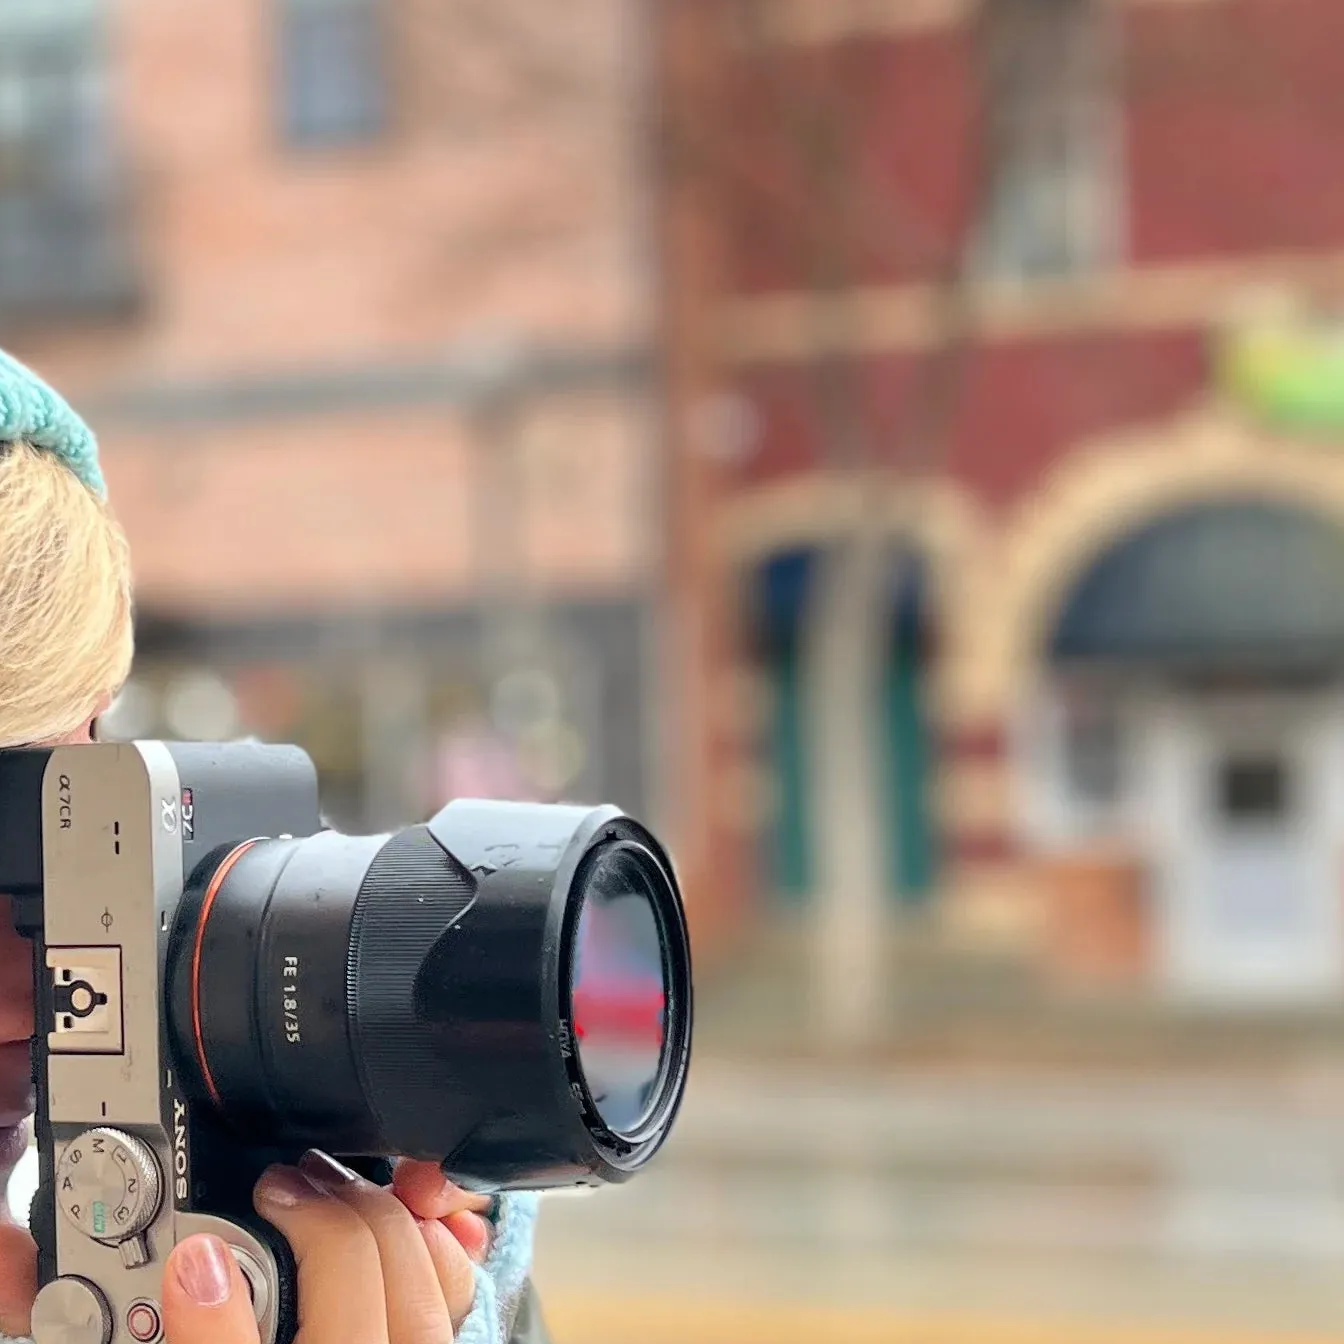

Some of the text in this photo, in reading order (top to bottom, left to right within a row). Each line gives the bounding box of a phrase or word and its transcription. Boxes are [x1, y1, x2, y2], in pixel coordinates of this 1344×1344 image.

[283, 956, 301, 1043] FE 1.8/35
[92, 1138, 105, 1153] M
[173, 1098, 188, 1200] SONY
[69, 1149, 83, 1164] S
[62, 1176, 73, 1190] A
[127, 1178, 137, 1194] 2
[70, 1204, 81, 1220] P
[117, 1206, 130, 1220] 3
